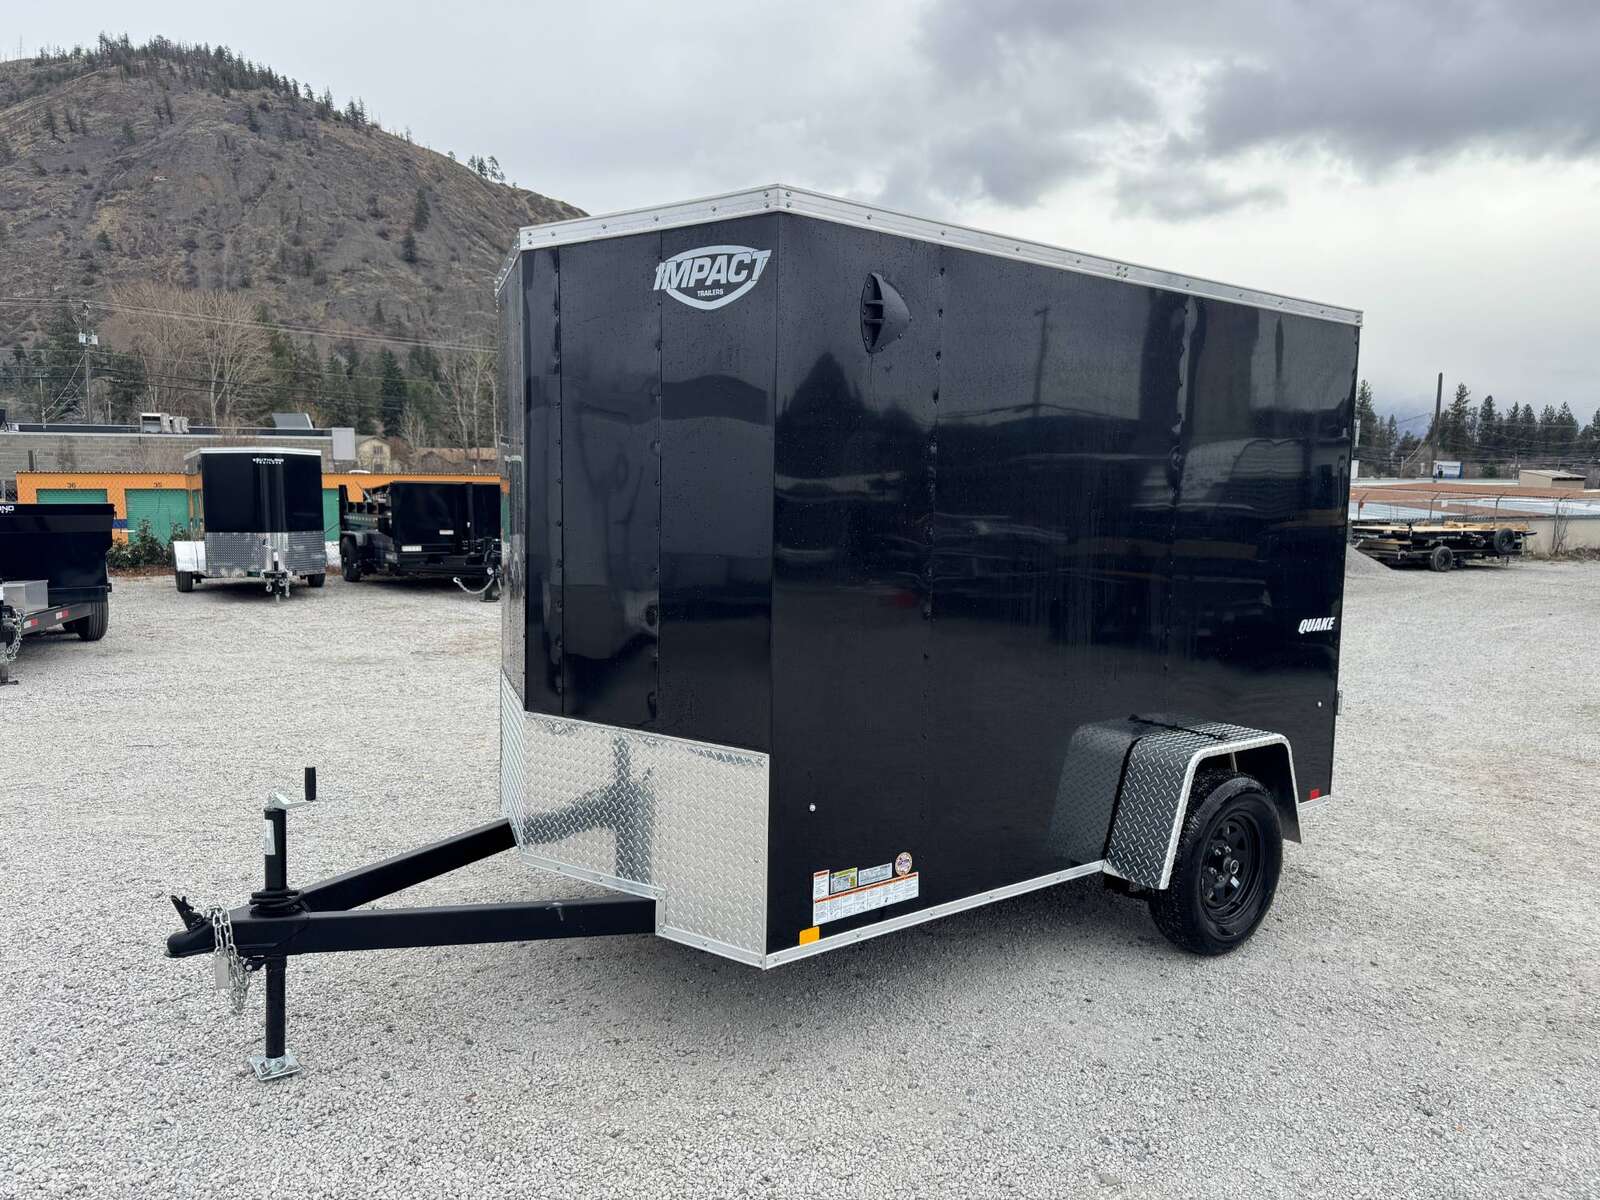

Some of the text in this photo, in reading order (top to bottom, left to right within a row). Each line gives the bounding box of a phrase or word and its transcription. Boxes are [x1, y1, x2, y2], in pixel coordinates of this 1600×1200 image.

[653, 249, 772, 291] IMPACT
[697, 288, 724, 297] TRAILERS
[1297, 616, 1336, 634] QUAKE
